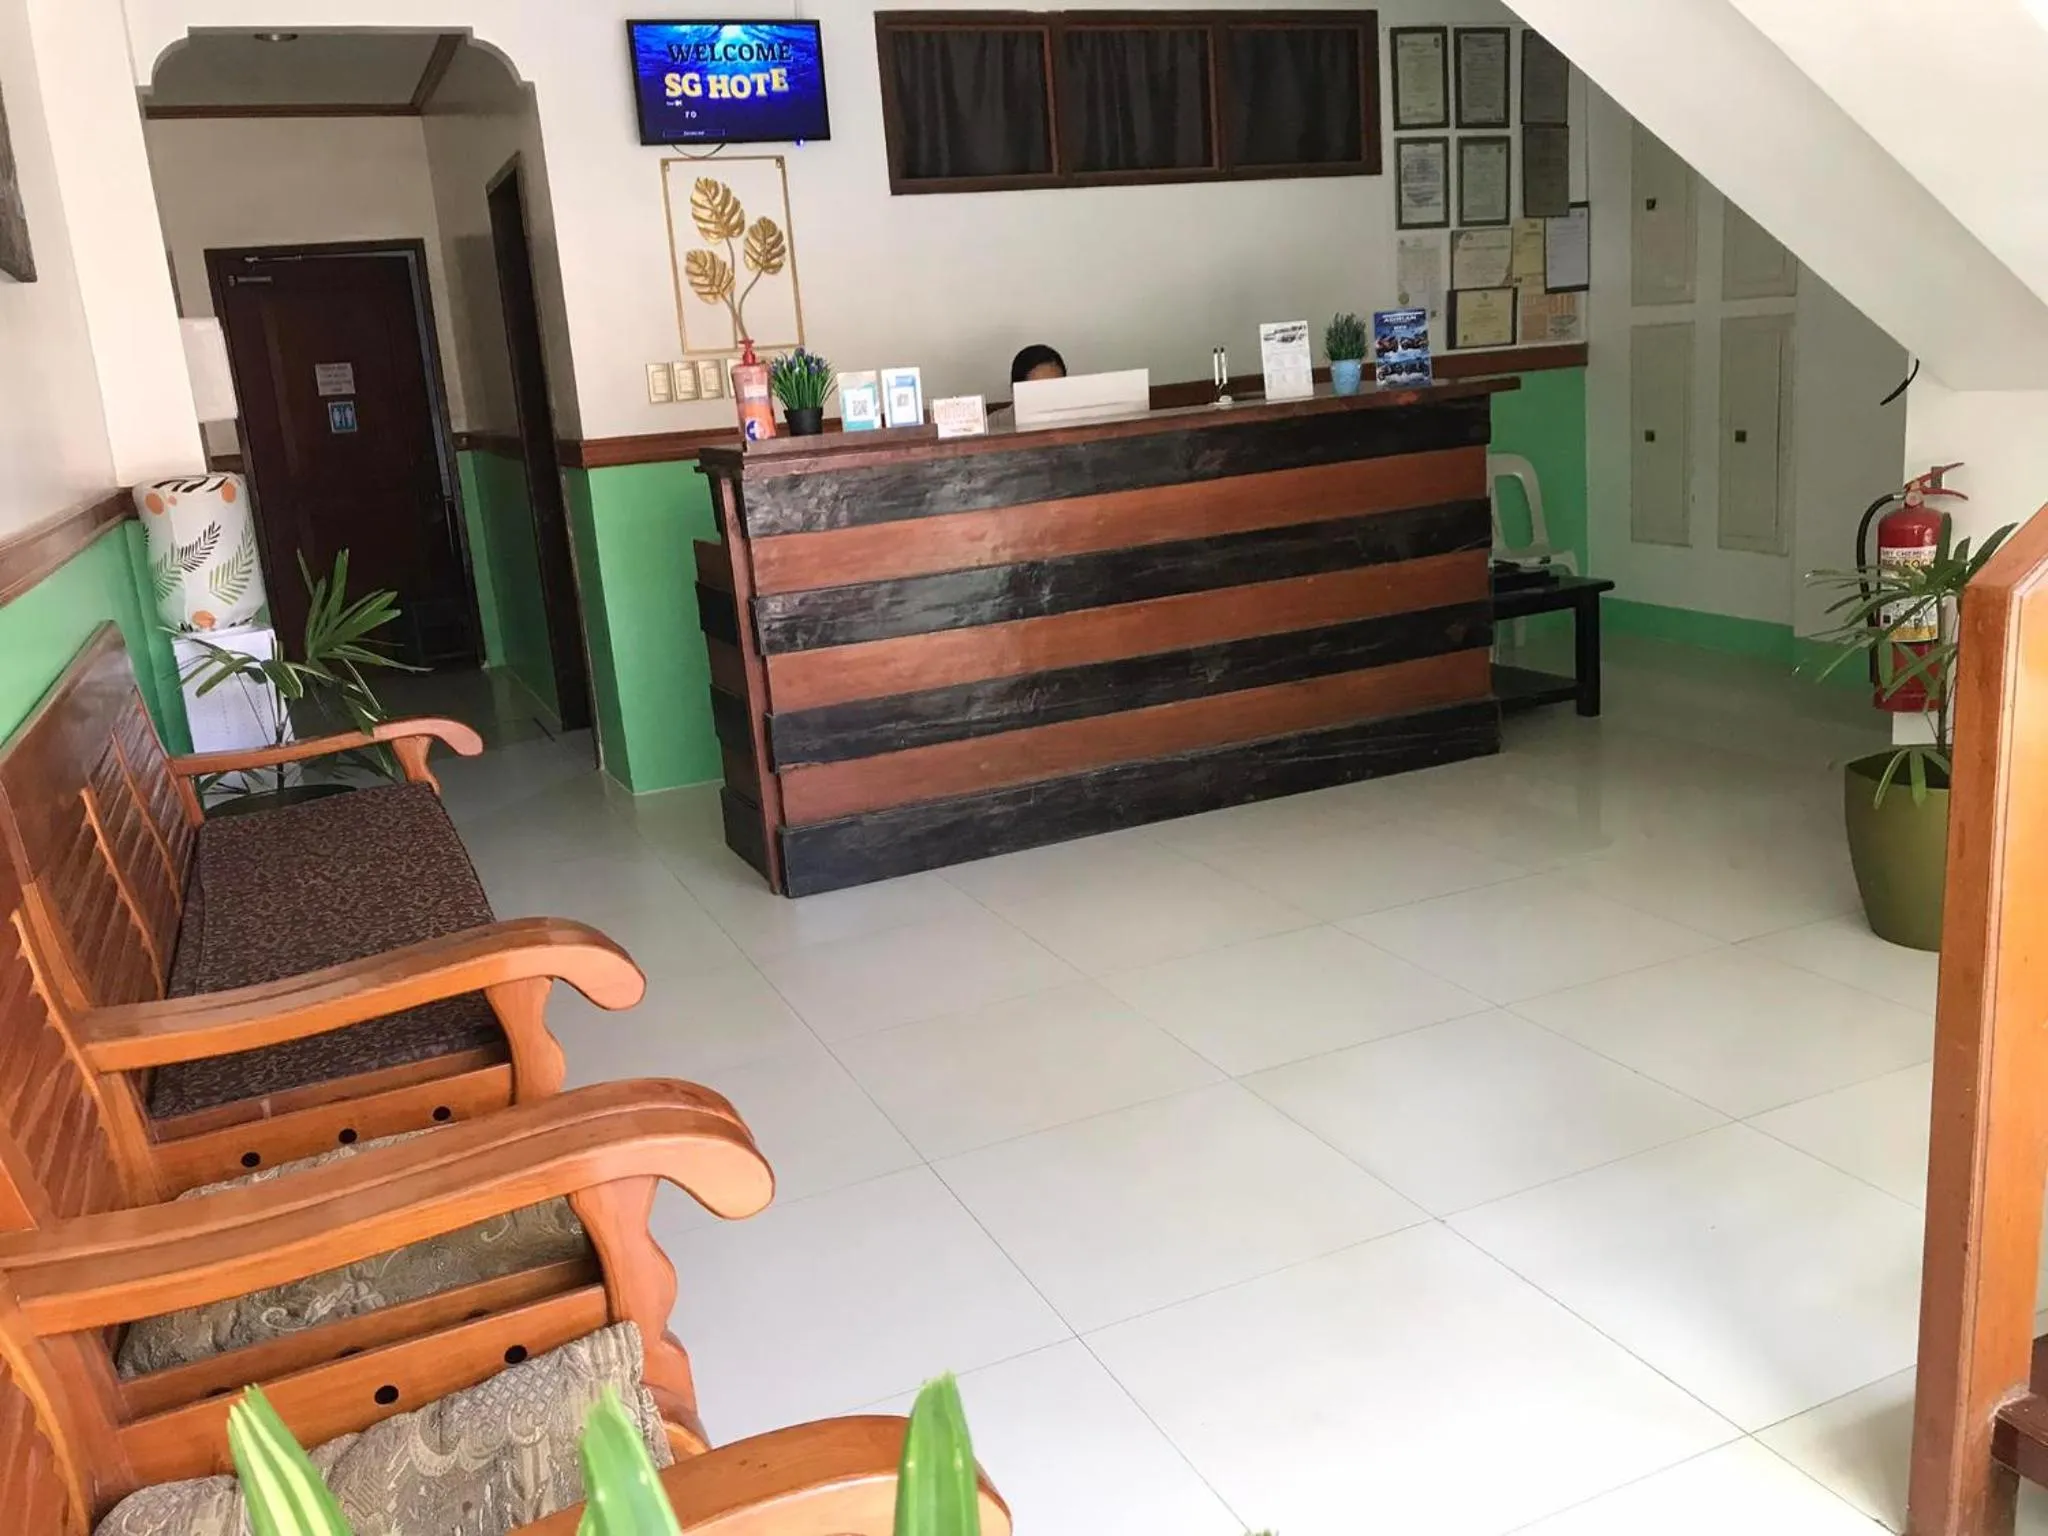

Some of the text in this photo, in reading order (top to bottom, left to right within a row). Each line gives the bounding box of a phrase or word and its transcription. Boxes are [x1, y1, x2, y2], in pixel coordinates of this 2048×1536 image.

[668, 42, 793, 64] WELCOME
[664, 67, 789, 98] SG HOTE
